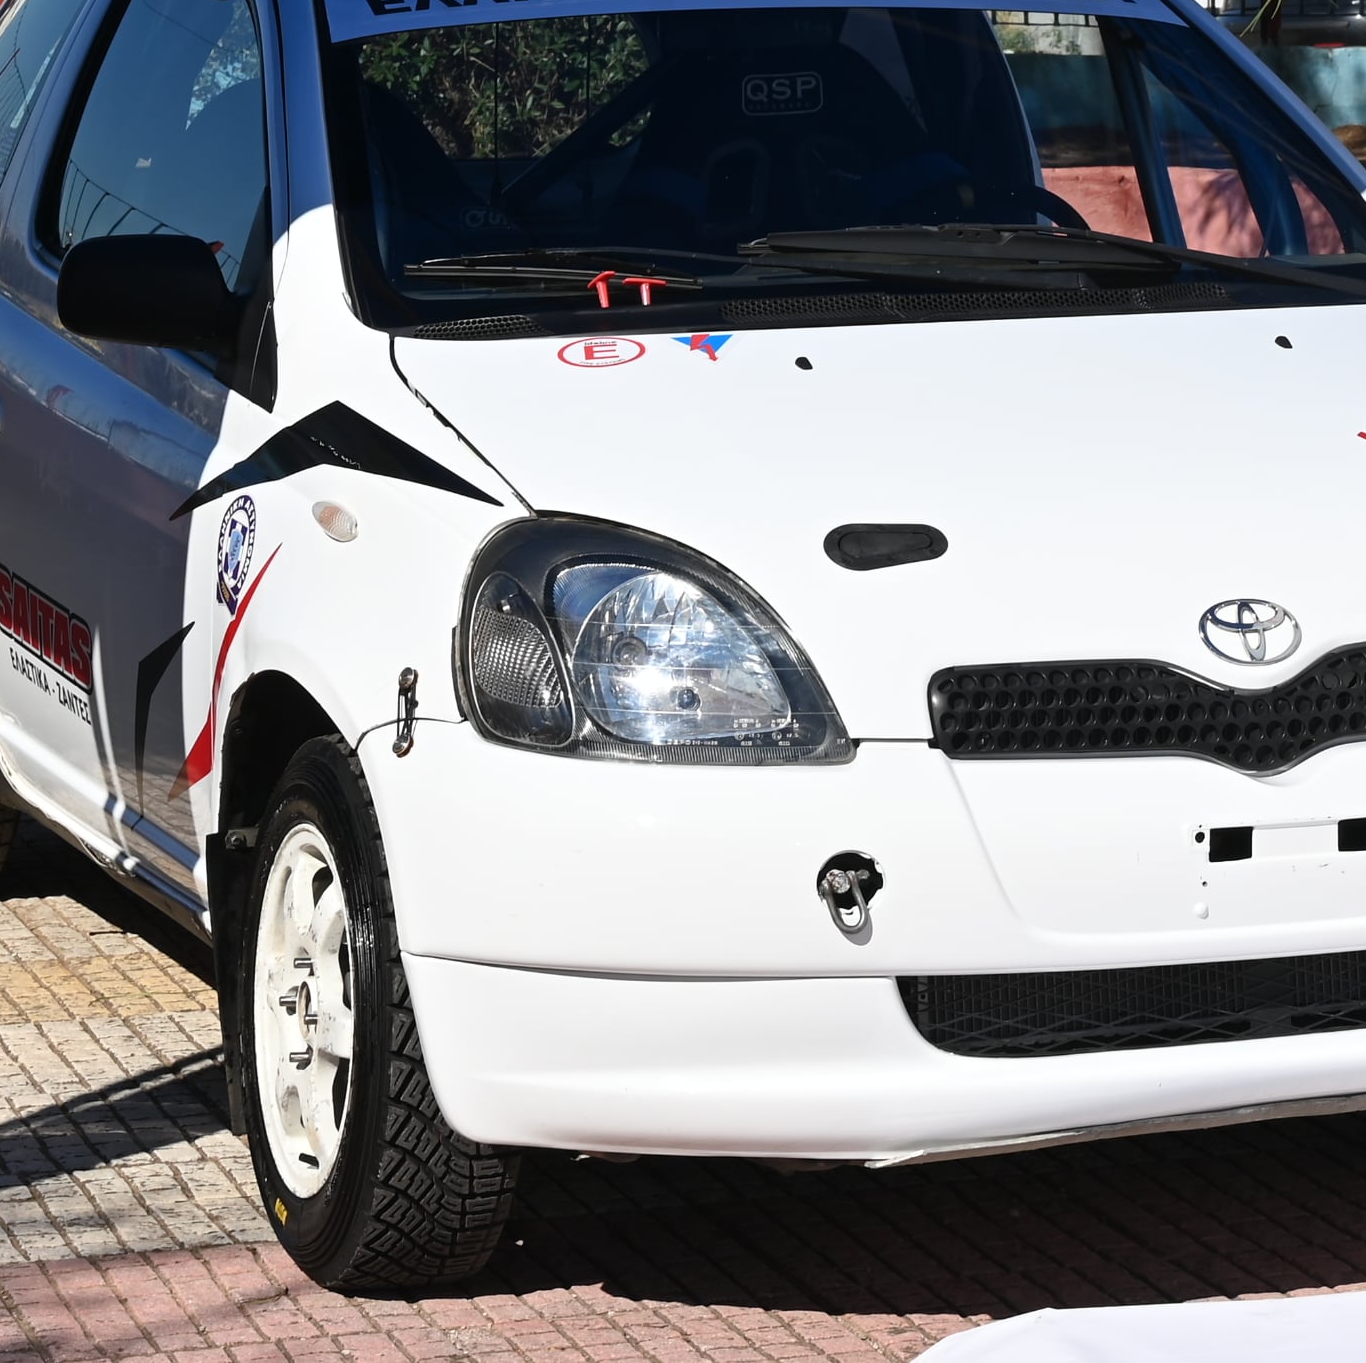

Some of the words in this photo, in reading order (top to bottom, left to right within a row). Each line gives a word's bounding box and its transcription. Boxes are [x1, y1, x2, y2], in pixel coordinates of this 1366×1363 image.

[746, 76, 818, 103] QSP
[9, 647, 52, 697] ΕΛΑΣΤΙΚΑ
[55, 680, 92, 726] ΖΑΝΤΕΣ
